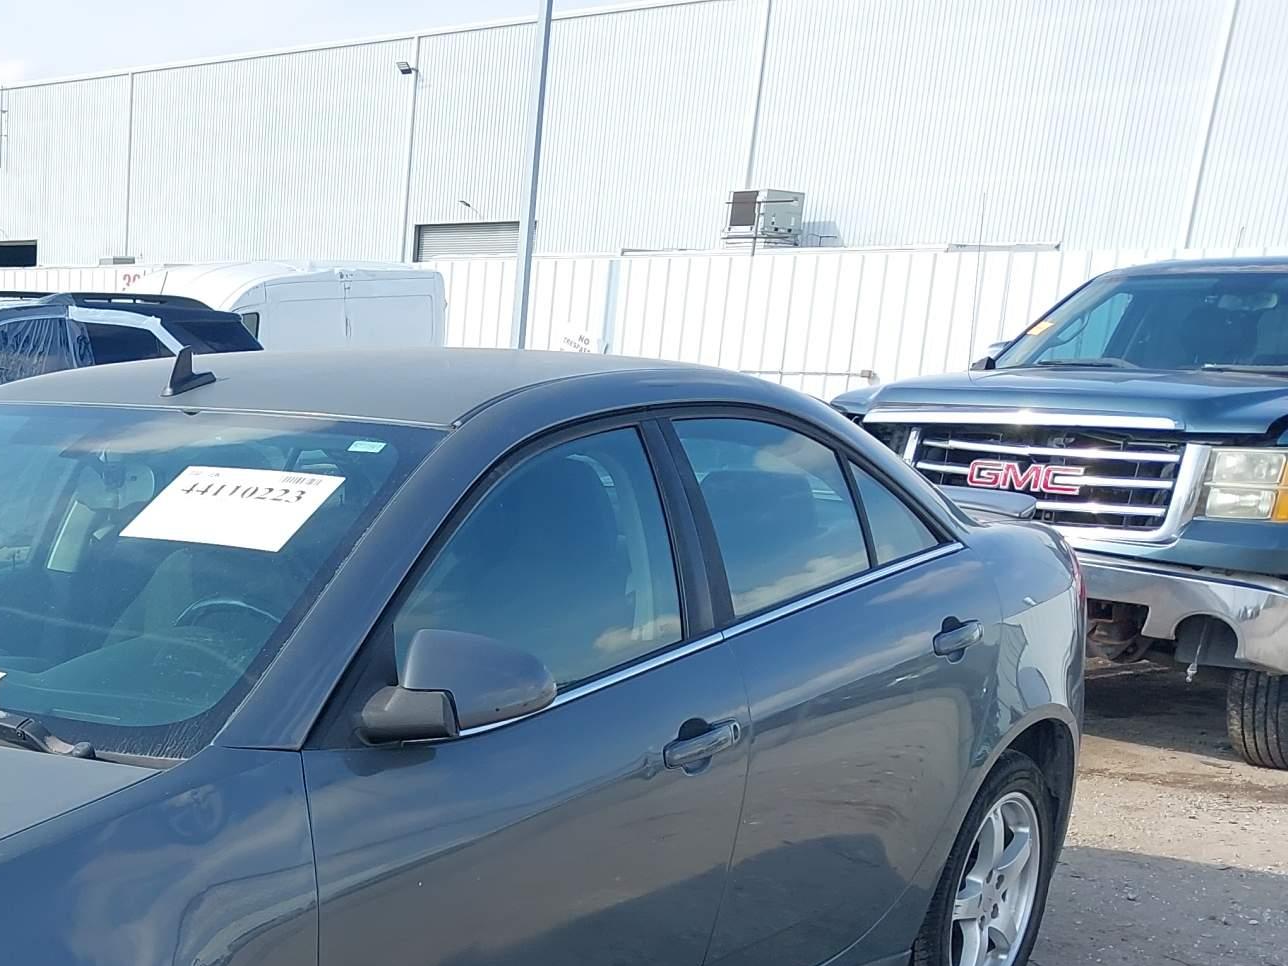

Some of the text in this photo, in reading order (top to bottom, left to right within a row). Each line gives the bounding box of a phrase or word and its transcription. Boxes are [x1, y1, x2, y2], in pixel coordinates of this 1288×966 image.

[578, 334, 591, 345] NO
[967, 459, 1085, 496] GMC
[181, 482, 306, 503] 44110223
